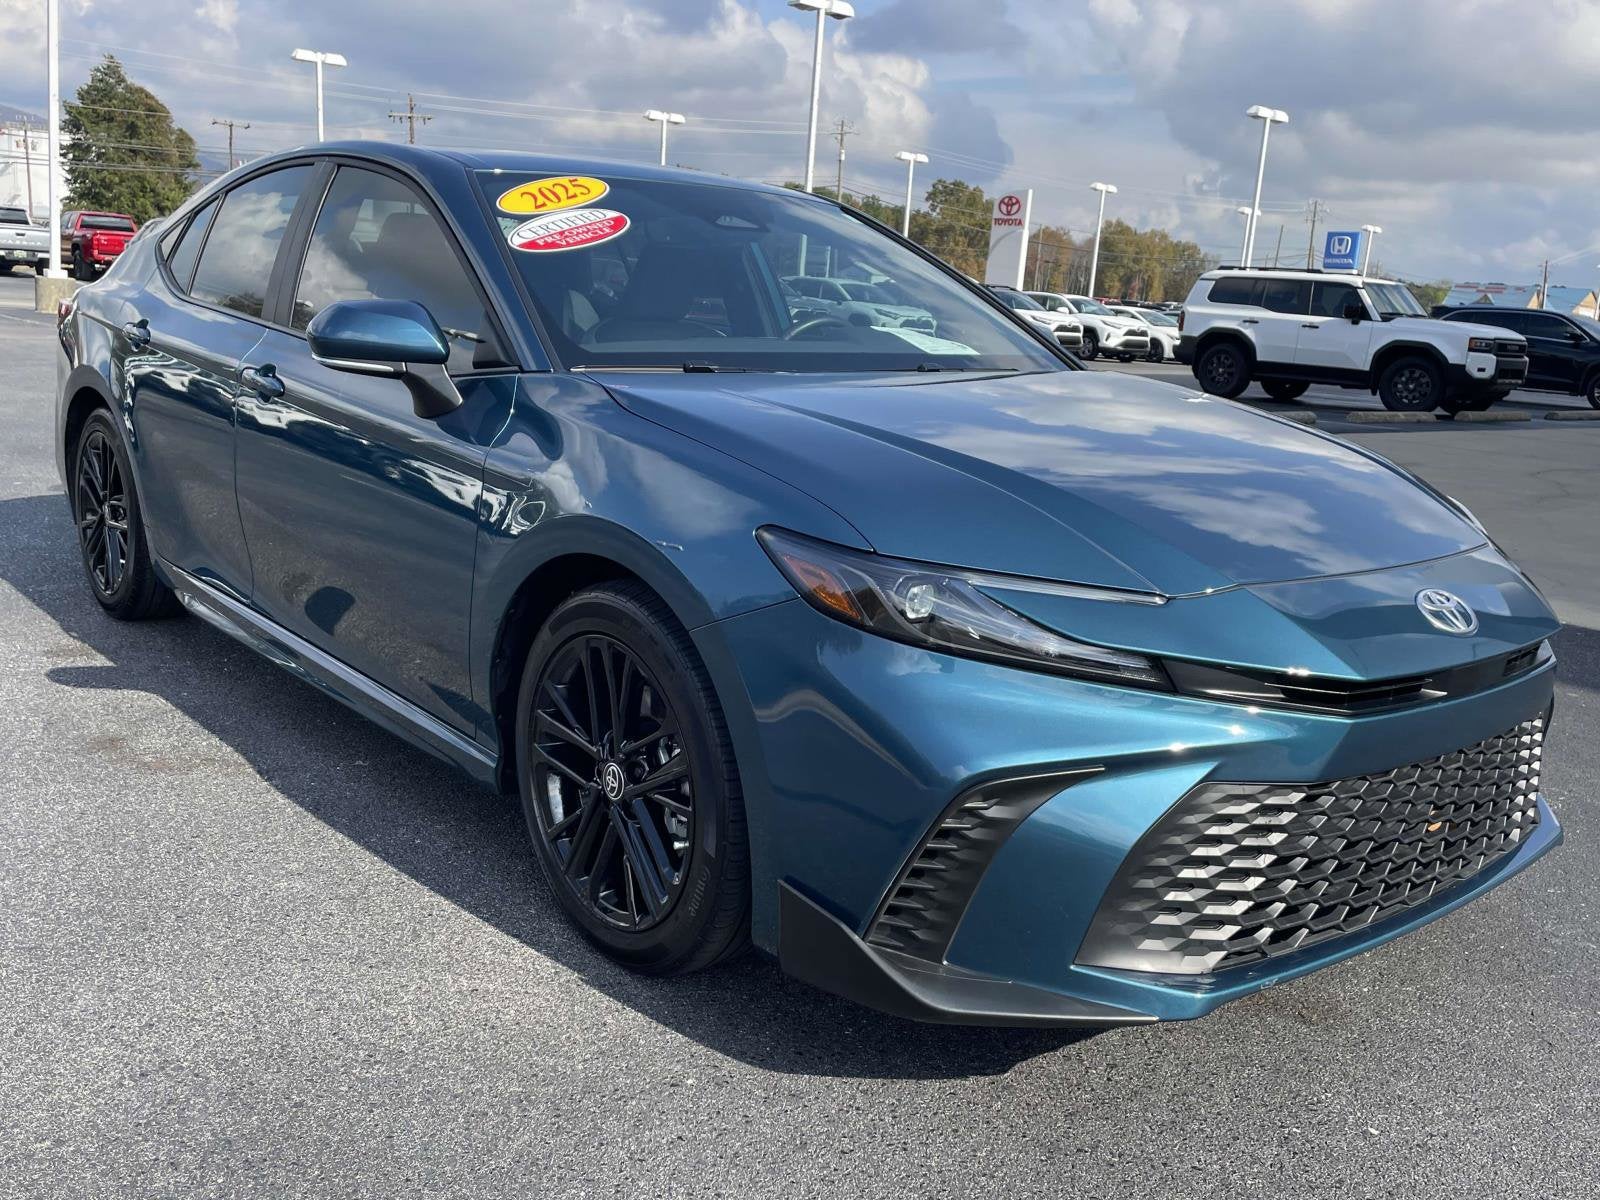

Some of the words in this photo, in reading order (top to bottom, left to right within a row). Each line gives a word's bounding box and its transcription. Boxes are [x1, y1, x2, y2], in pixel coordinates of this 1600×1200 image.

[521, 178, 591, 209] 2025
[517, 210, 607, 239] CERTIFIED
[535, 220, 615, 246] PRE-OWNED
[994, 218, 1023, 226] TOYOTA
[556, 227, 614, 246] VEHICLE
